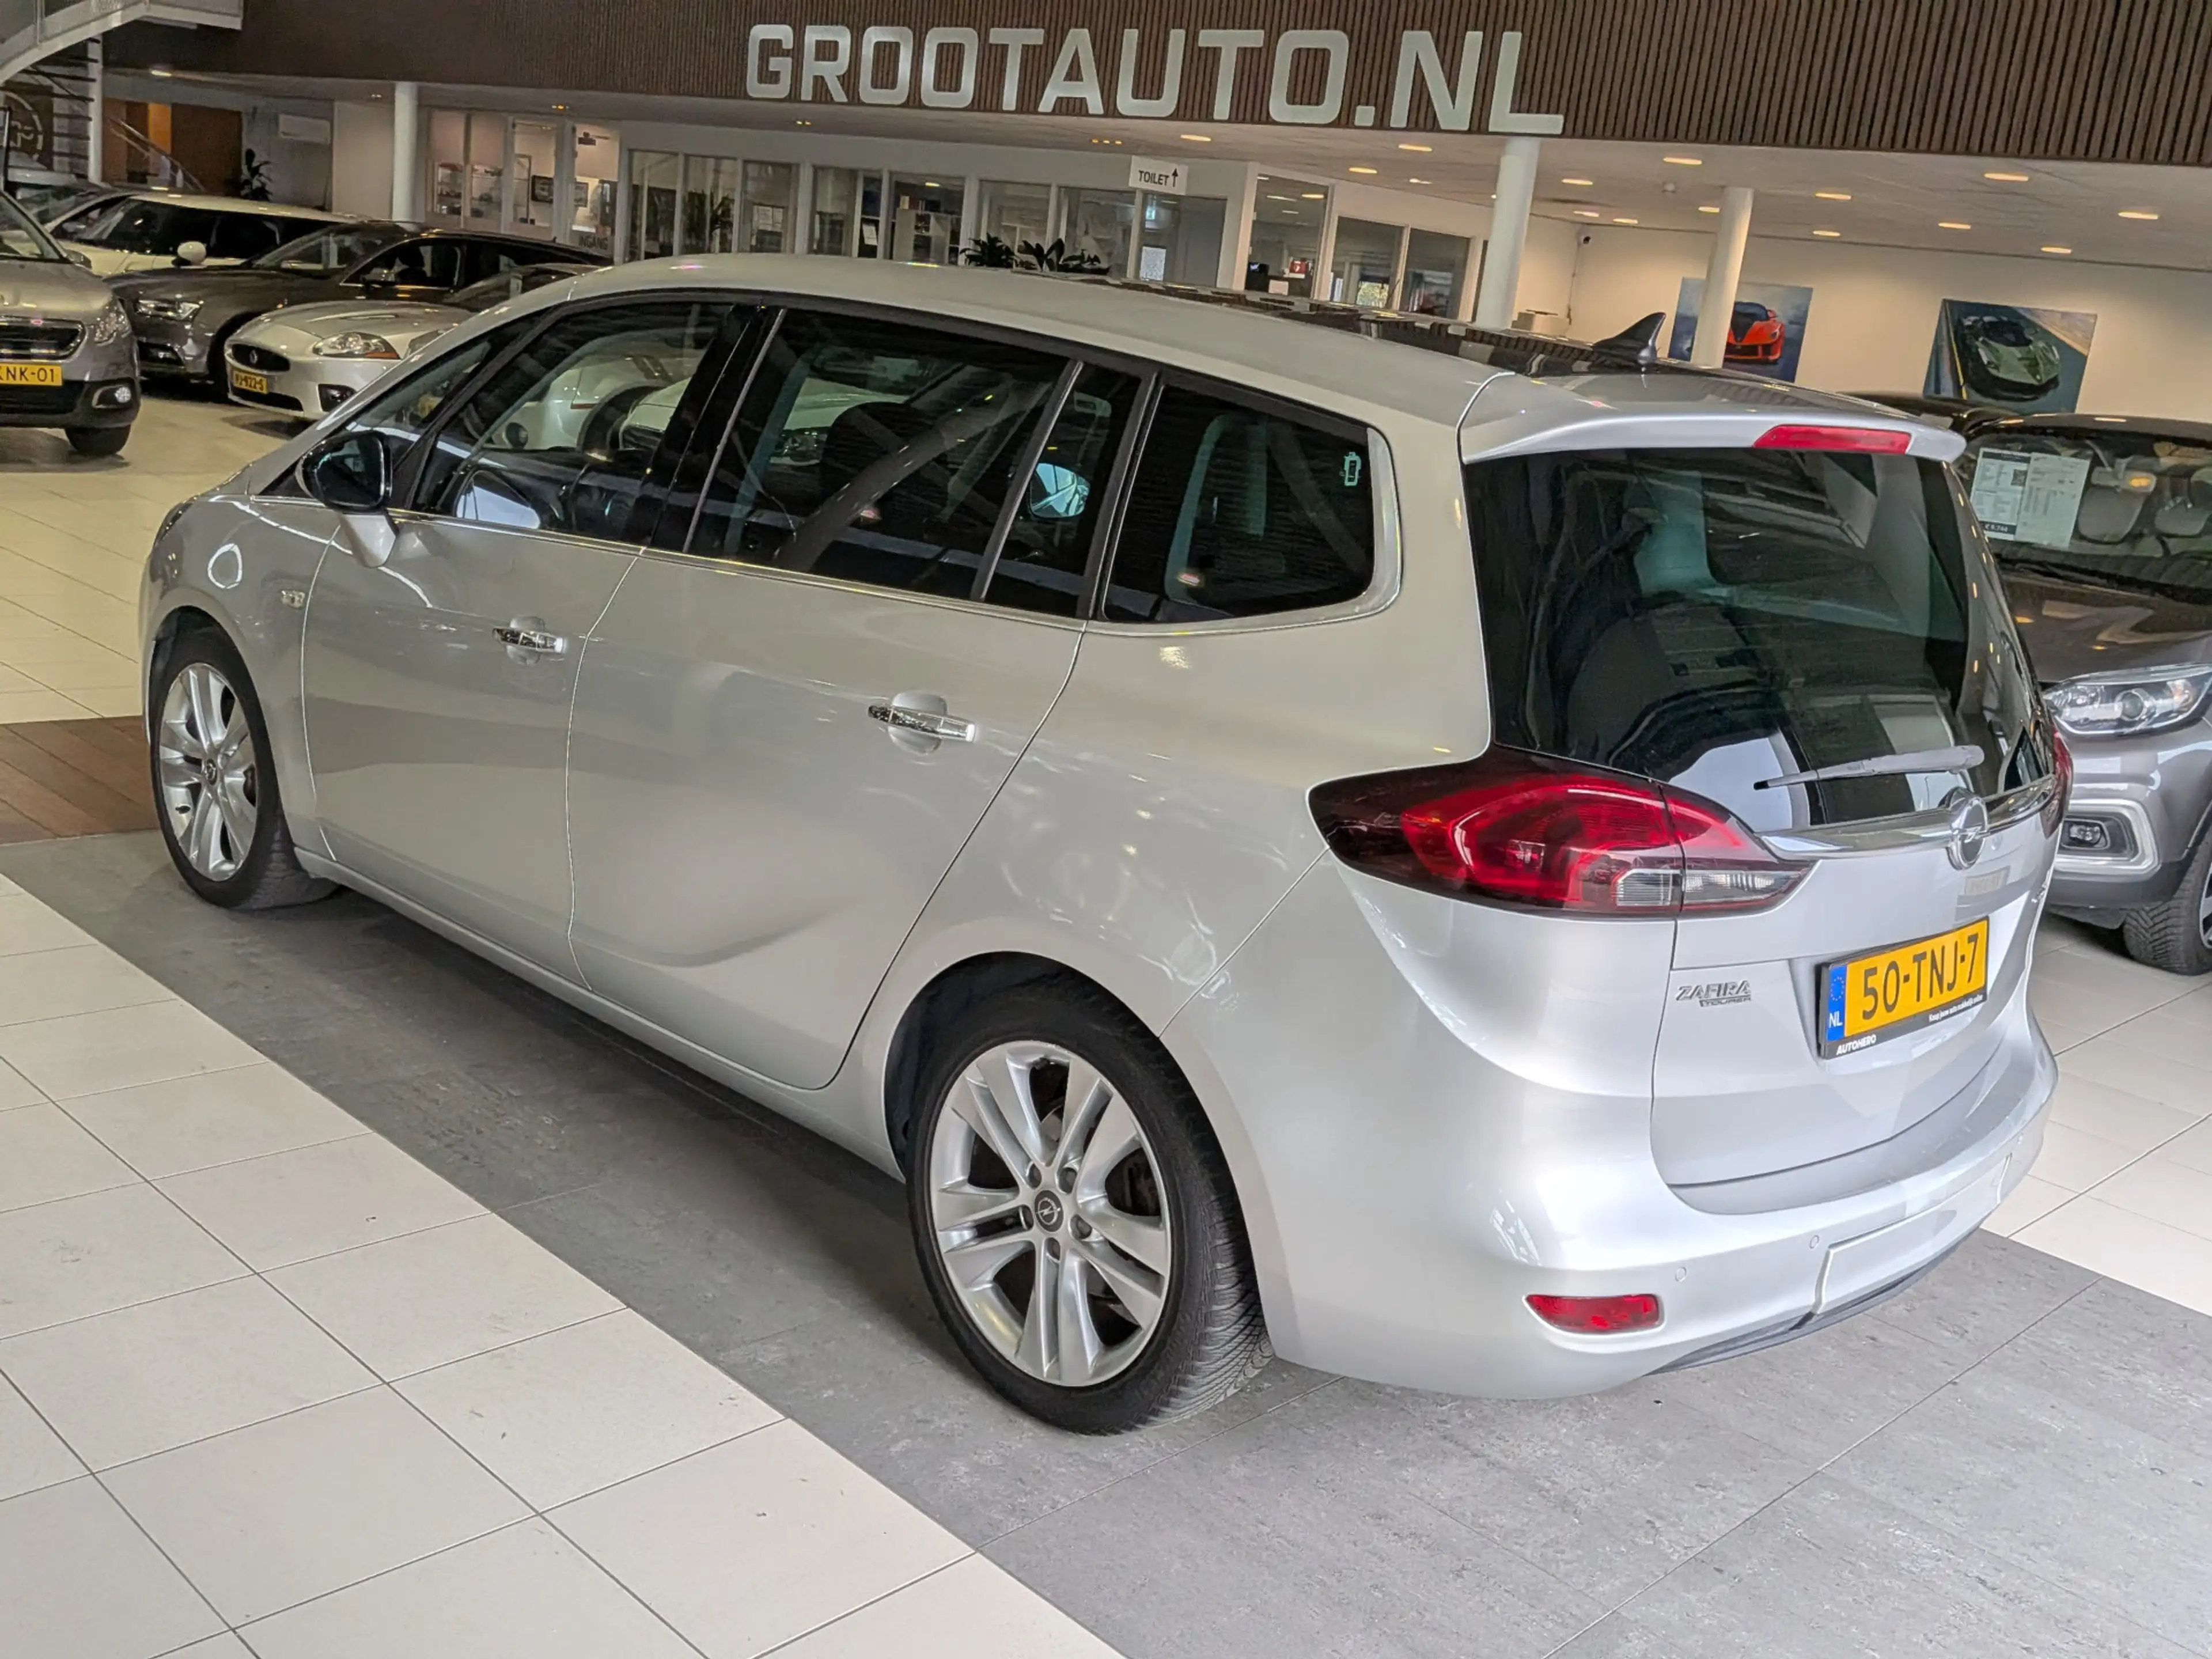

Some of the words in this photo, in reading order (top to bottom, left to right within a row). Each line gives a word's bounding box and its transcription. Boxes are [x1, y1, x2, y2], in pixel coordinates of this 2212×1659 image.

[745, 24, 1565, 134] GROOTAUTO.NL
[1139, 169, 1169, 186] TOILET
[1862, 933, 1979, 1021] 50-TNJ-7
[1676, 980, 1751, 1001] ZAFIRA
[1828, 1010, 1843, 1028] NL
[1836, 1034, 1877, 1055] AUTOHERO
